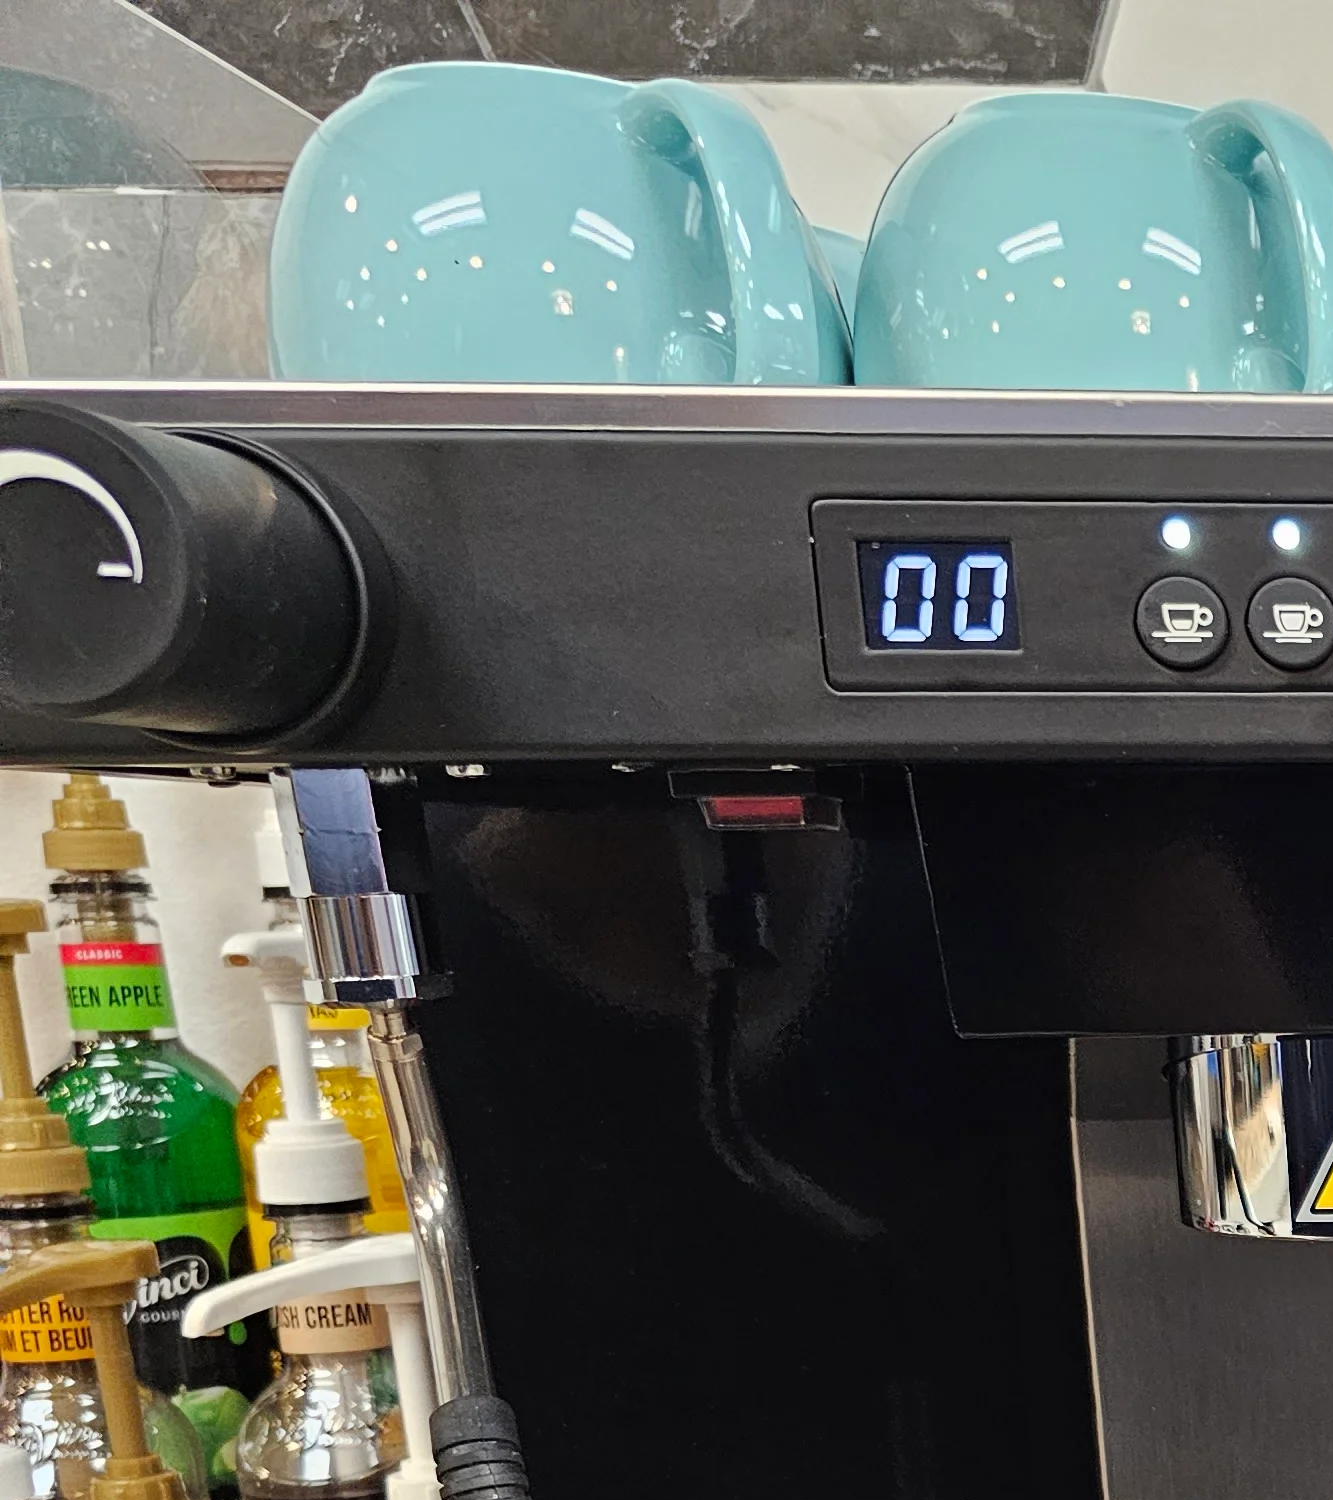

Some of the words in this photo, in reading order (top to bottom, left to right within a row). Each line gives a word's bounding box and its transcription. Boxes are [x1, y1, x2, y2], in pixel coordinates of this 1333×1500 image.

[881, 555, 1009, 642] 00
[109, 984, 165, 1008] APPLE
[305, 1301, 373, 1329] CREAM
[20, 1329, 42, 1353] ET
